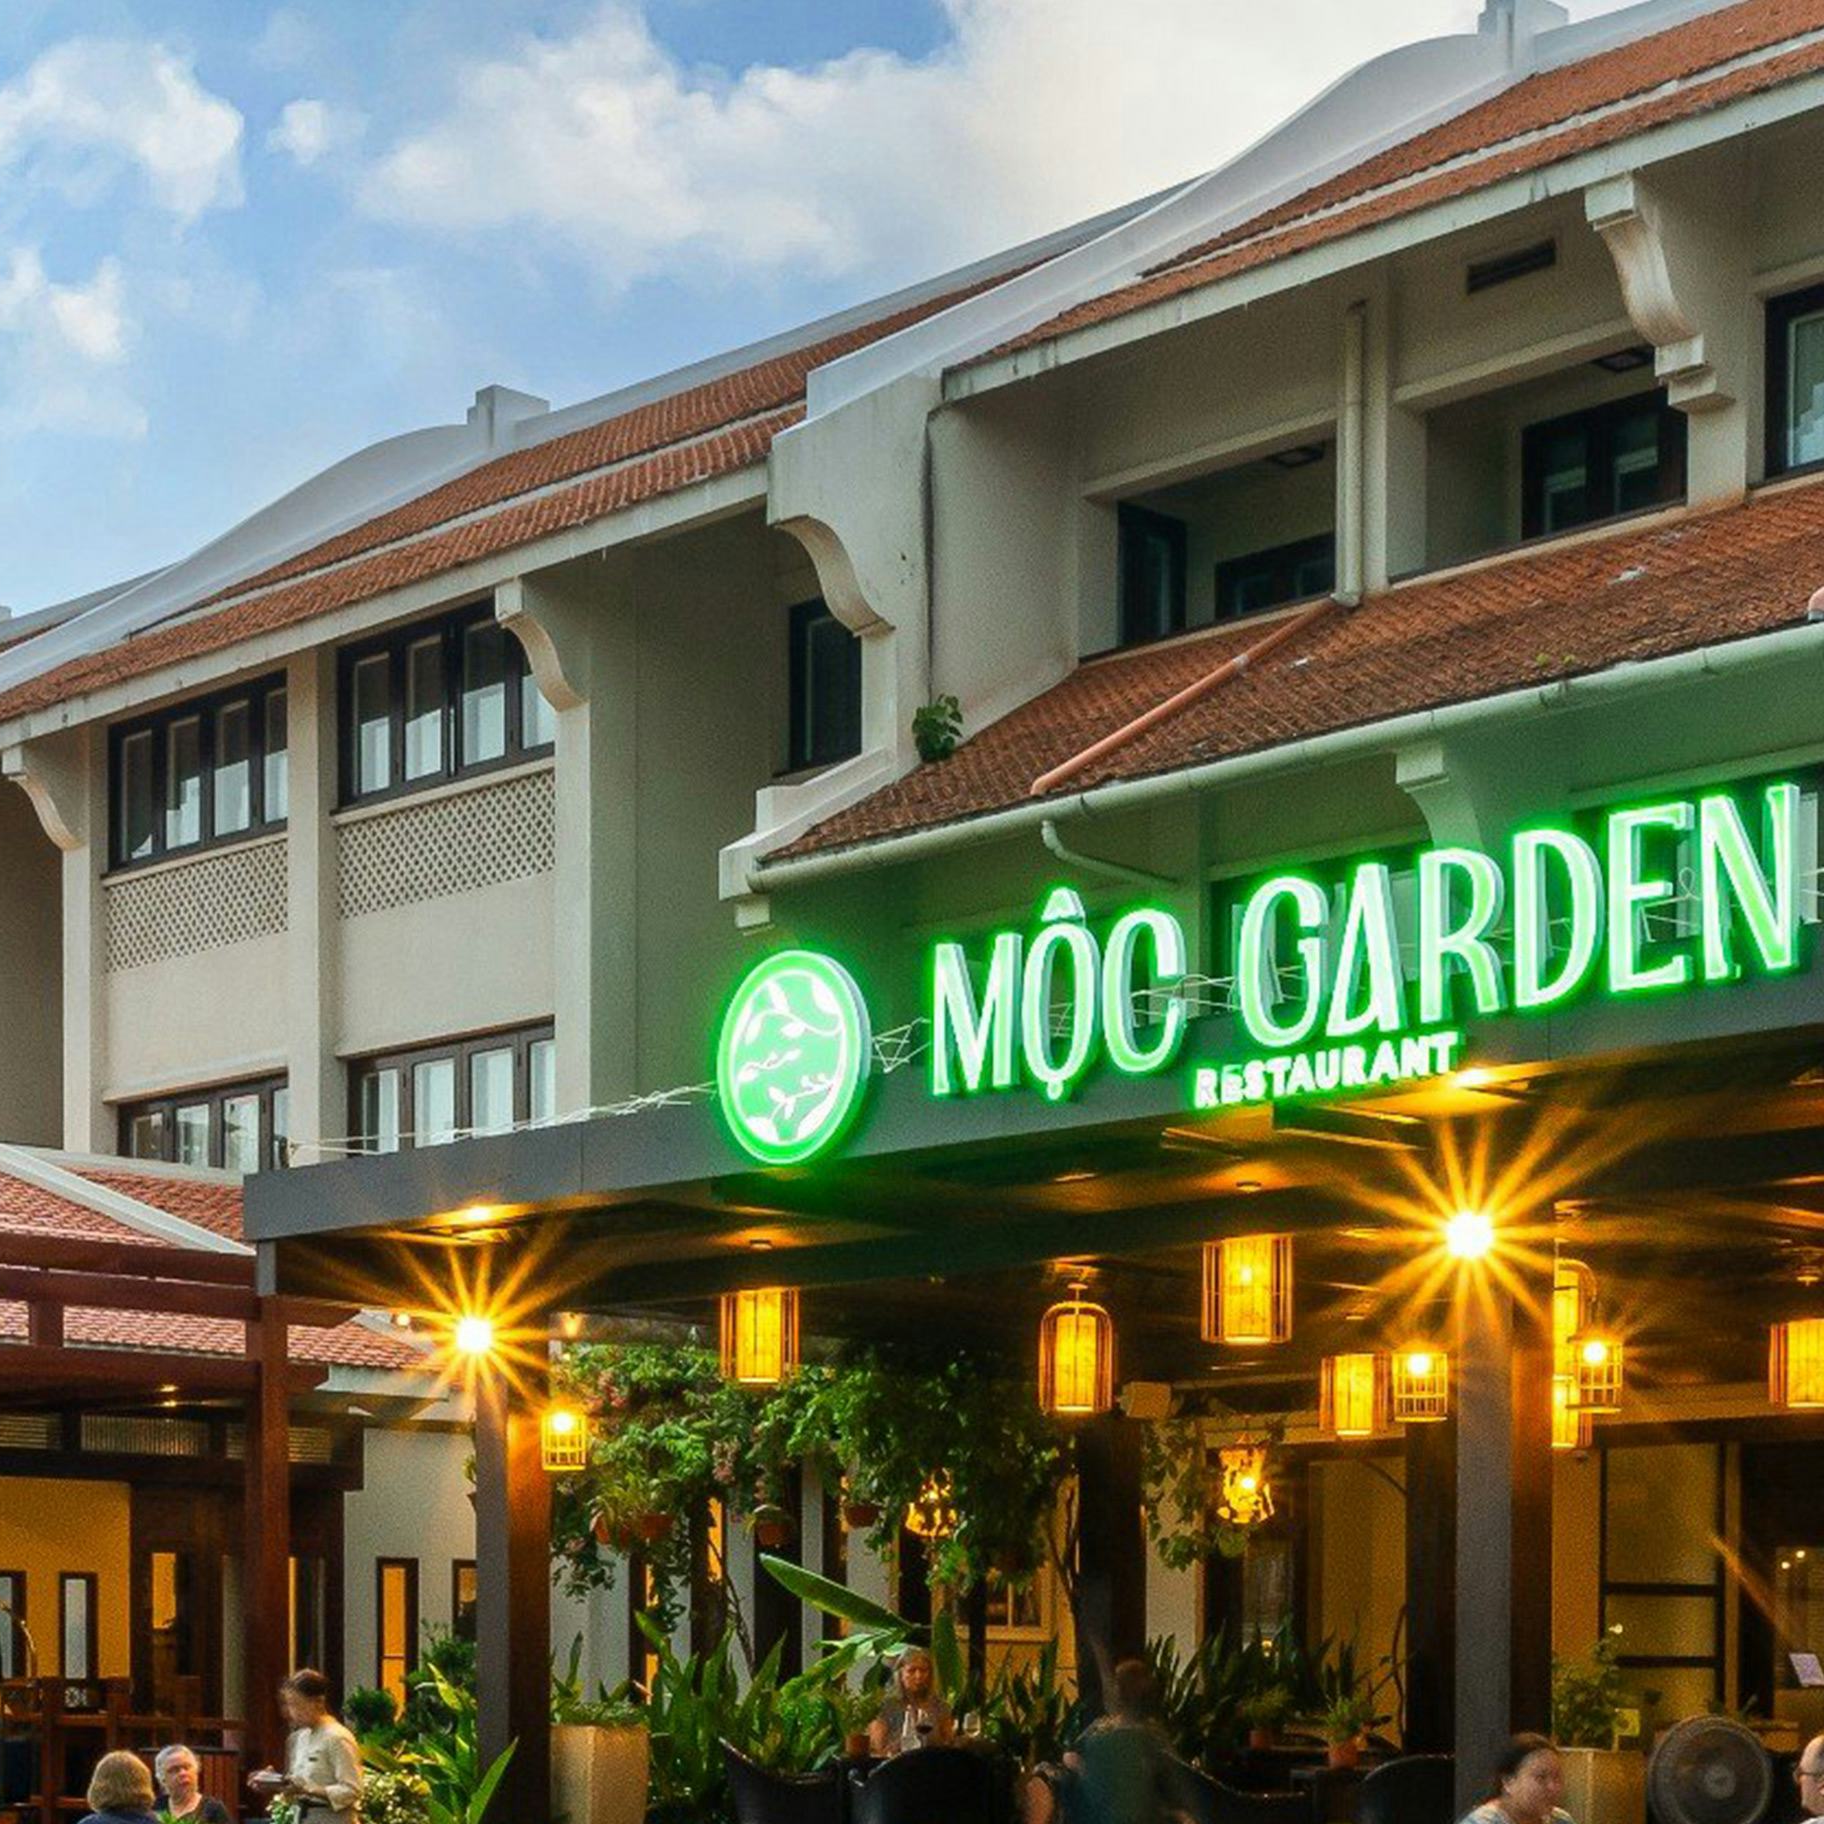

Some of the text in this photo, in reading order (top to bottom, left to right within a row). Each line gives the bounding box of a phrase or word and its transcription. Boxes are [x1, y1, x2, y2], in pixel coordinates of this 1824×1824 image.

[933, 784, 1799, 1100] MỘC GARDEN
[1194, 1032, 1458, 1109] RESTAURANT
